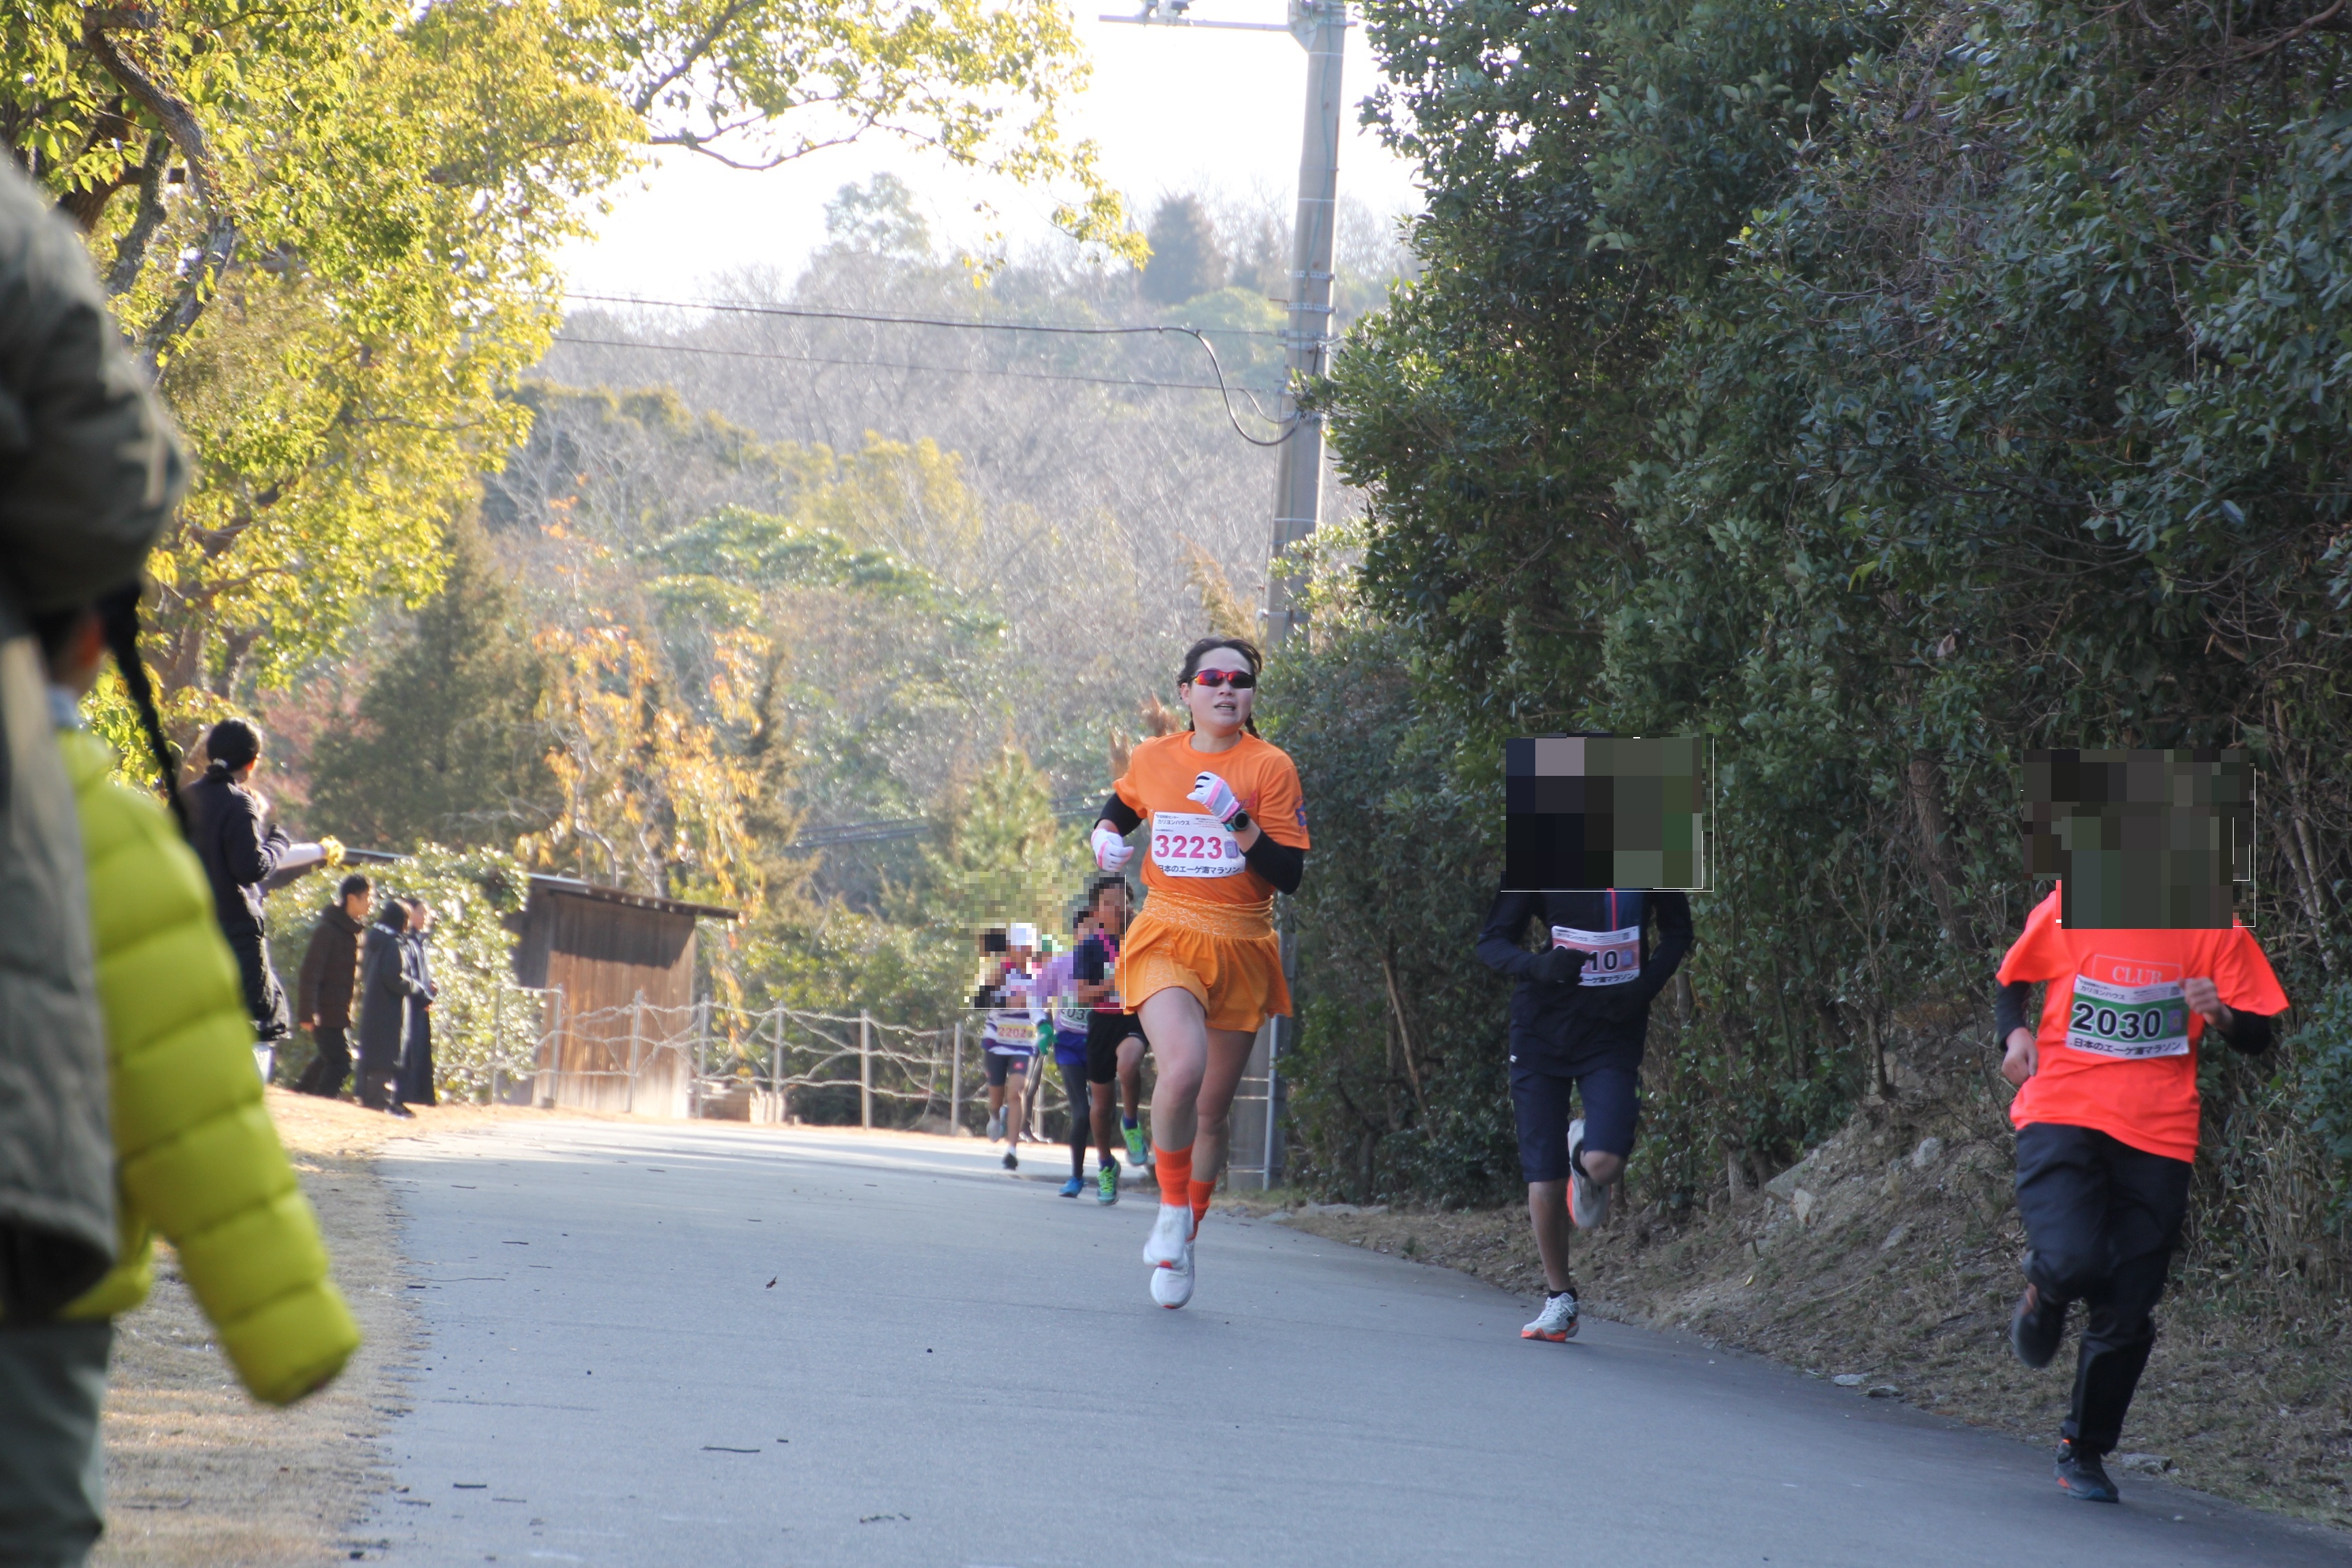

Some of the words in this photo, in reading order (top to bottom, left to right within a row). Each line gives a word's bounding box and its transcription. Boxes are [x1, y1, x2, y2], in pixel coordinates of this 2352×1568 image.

[1154, 834, 1222, 860] 3223
[2112, 966, 2163, 984] CLUB
[2080, 985, 2125, 1000] カリヨンハウス
[2072, 1002, 2161, 1039] 2030
[998, 1026, 1026, 1038] 2202
[2074, 1038, 2180, 1055] 日本のエーゲ海マラソン
